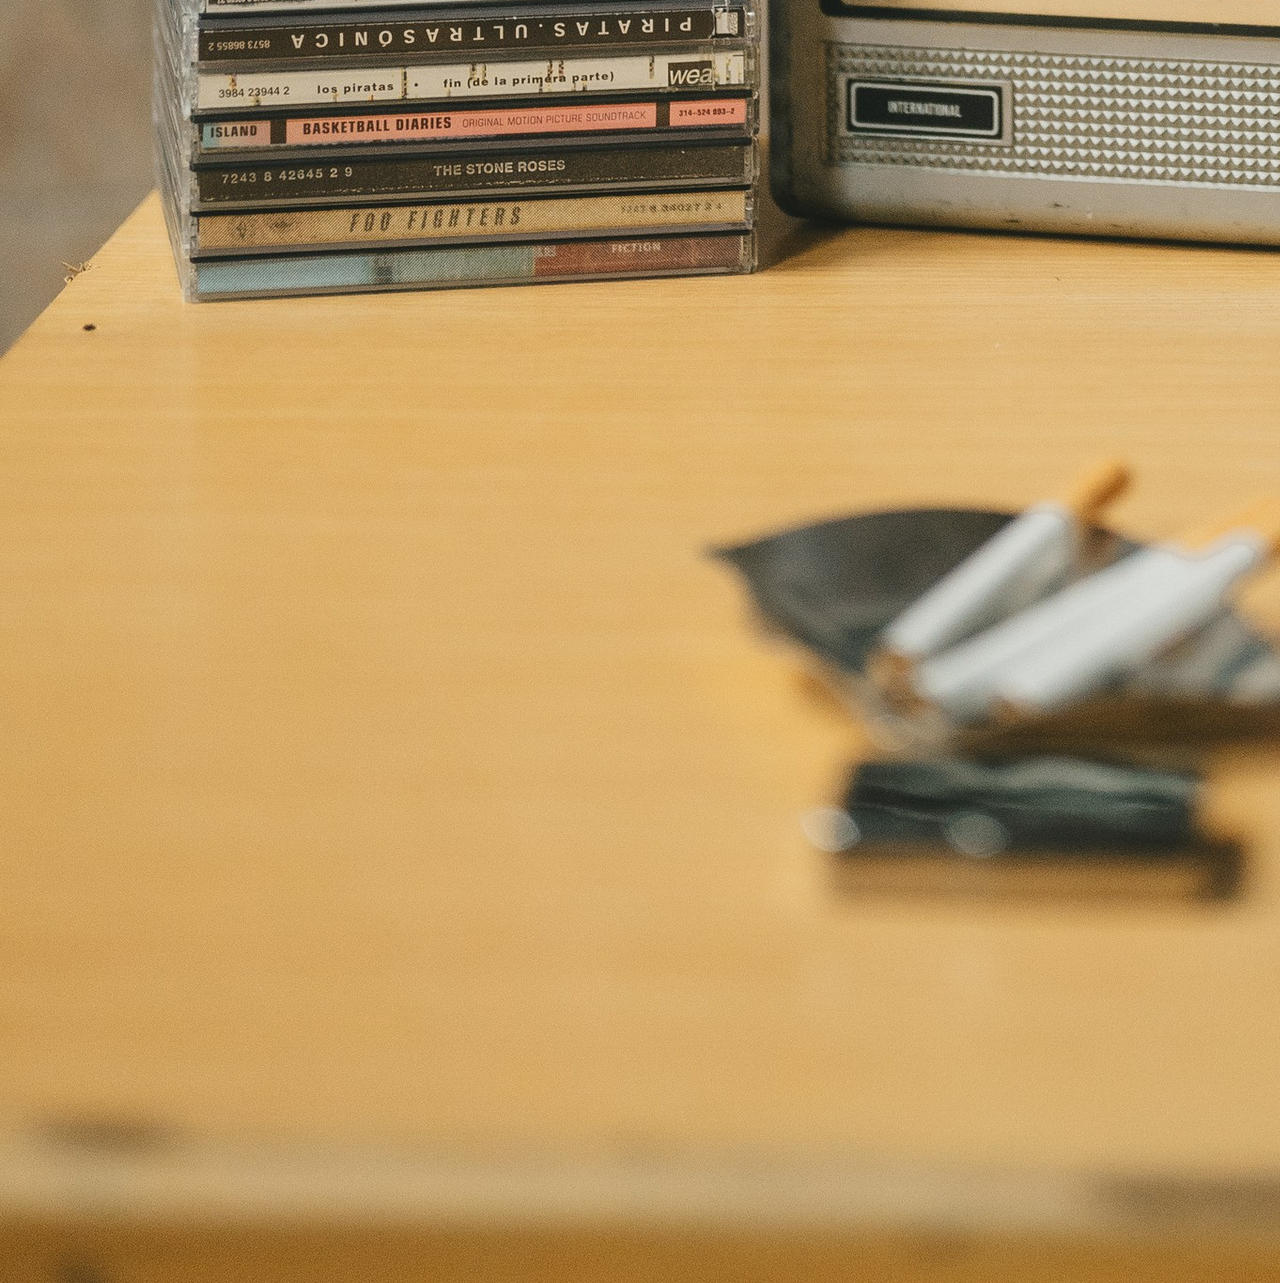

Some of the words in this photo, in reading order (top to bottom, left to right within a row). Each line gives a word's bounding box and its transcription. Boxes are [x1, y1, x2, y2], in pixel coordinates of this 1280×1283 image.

[207, 42, 214, 51] 2
[216, 40, 245, 51] 86855
[247, 39, 271, 49] 8573
[317, 84, 338, 94] los
[343, 82, 394, 95] piratas
[443, 78, 462, 88] fin
[467, 77, 489, 89] (de
[494, 76, 507, 86] la
[512, 74, 566, 86] primera
[572, 71, 615, 85] parte)
[218, 88, 244, 98] 3984
[248, 86, 280, 97] 23944
[283, 86, 290, 95] 2
[303, 119, 390, 135] BASKETBALL
[396, 116, 452, 131] DIARIES
[462, 117, 504, 128] ORIGINAL
[507, 115, 543, 127] MOTION
[545, 113, 583, 125] PICTURE
[585, 111, 647, 122] SOUNDTRACK
[210, 125, 257, 138] ISLAND
[221, 172, 257, 184] 7243
[263, 171, 273, 182] 8
[279, 168, 324, 181] 42645
[329, 168, 338, 179] 2
[344, 166, 353, 178] 9
[433, 164, 462, 177] THE
[466, 161, 514, 175] STONE
[517, 159, 566, 174] ROSES
[349, 211, 392, 233] FOO
[407, 206, 522, 231] FIGHTERS
